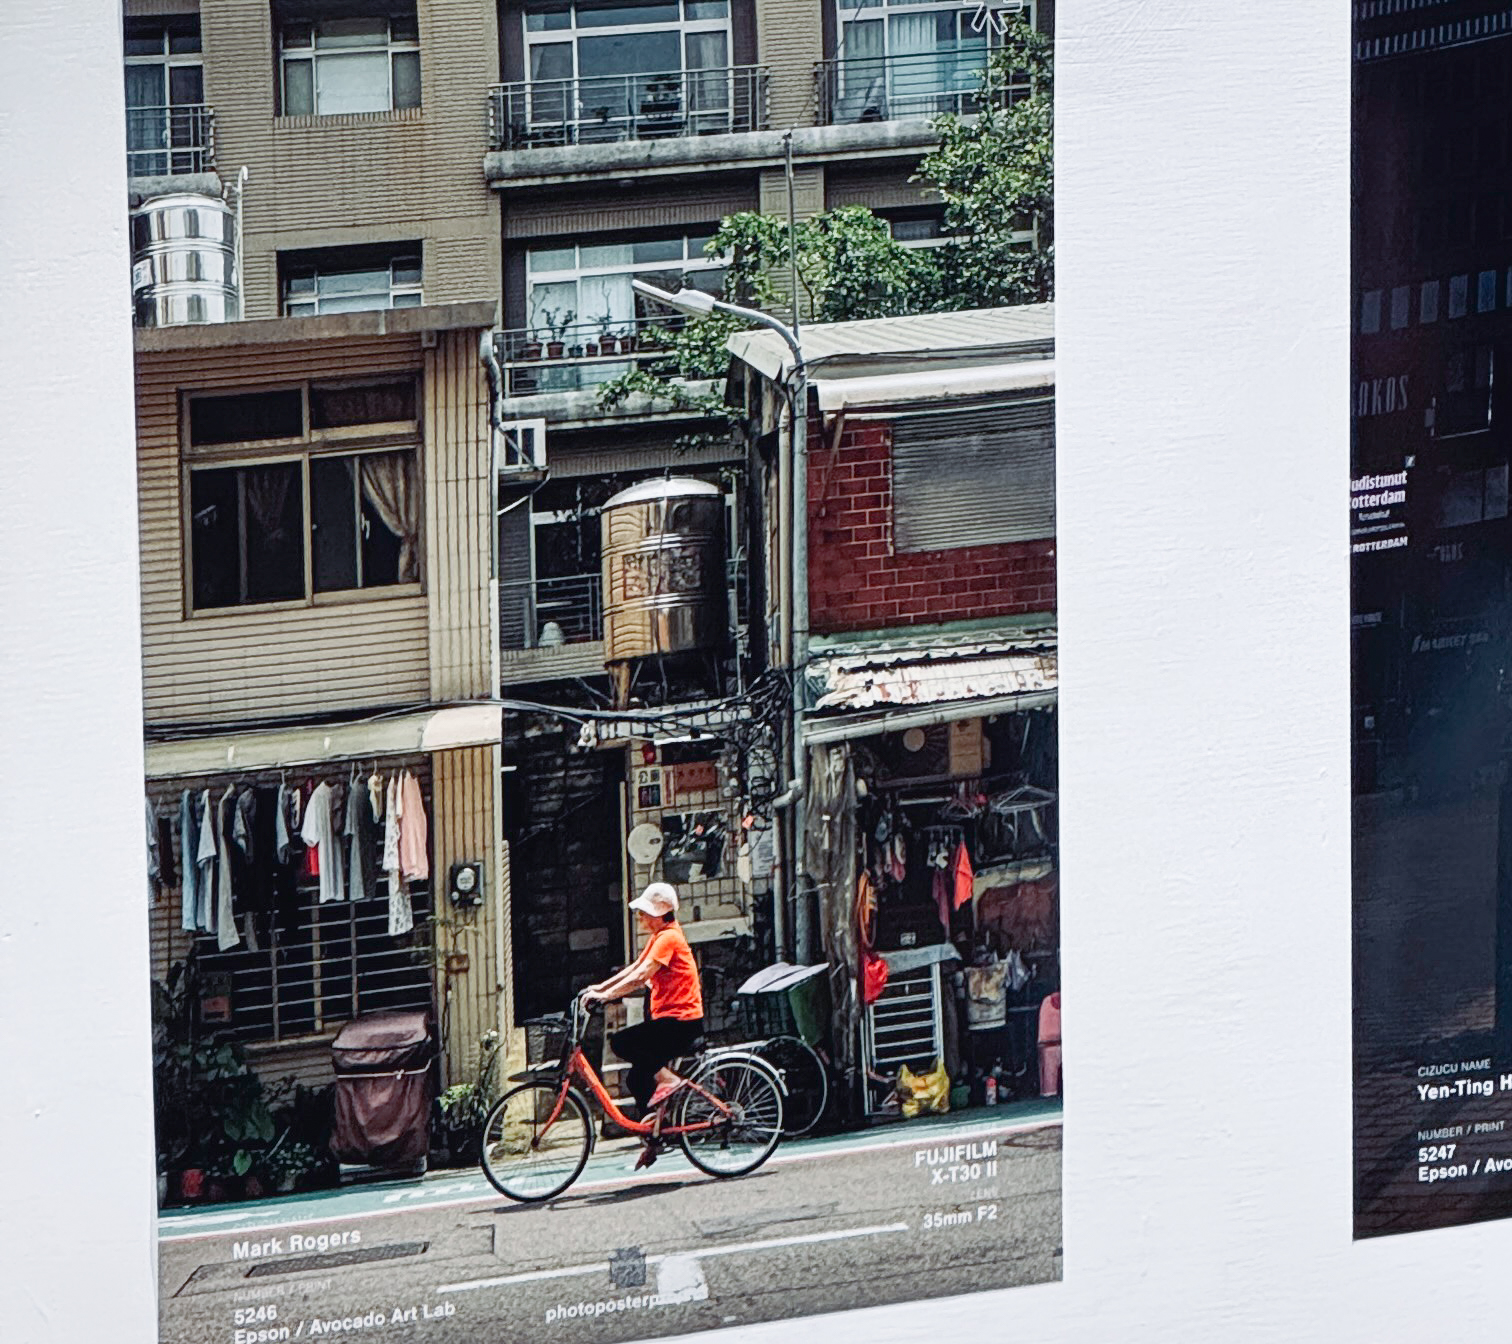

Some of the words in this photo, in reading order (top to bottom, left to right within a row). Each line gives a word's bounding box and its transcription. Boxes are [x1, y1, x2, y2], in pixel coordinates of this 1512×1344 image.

[1358, 375, 1409, 417] OKOS
[1350, 470, 1408, 492] udistunut
[1350, 490, 1406, 509] otterdam
[1352, 536, 1408, 554] ROTTERDAM
[1417, 1062, 1459, 1077] CIZUCU
[1461, 1058, 1491, 1072] NAME
[1417, 1078, 1494, 1101] Yen-Ting
[1418, 1125, 1463, 1141] NUMBER
[1474, 1121, 1505, 1134] PRINT
[914, 1140, 997, 1168] FUJIFILM
[1418, 1144, 1456, 1163] 5247
[931, 1163, 981, 1185] X-T30
[986, 1160, 997, 1178] II
[1418, 1163, 1467, 1183] Epson
[1472, 1159, 1480, 1176] /
[923, 1210, 972, 1229] 35mm
[977, 1205, 997, 1222] F2
[233, 1238, 282, 1259] Mark
[290, 1230, 361, 1252] Rogers
[234, 1304, 277, 1325] 5246
[296, 1322, 303, 1337] /
[310, 1311, 385, 1336] Avocado
[391, 1305, 417, 1323] Art
[422, 1300, 455, 1320] Lab
